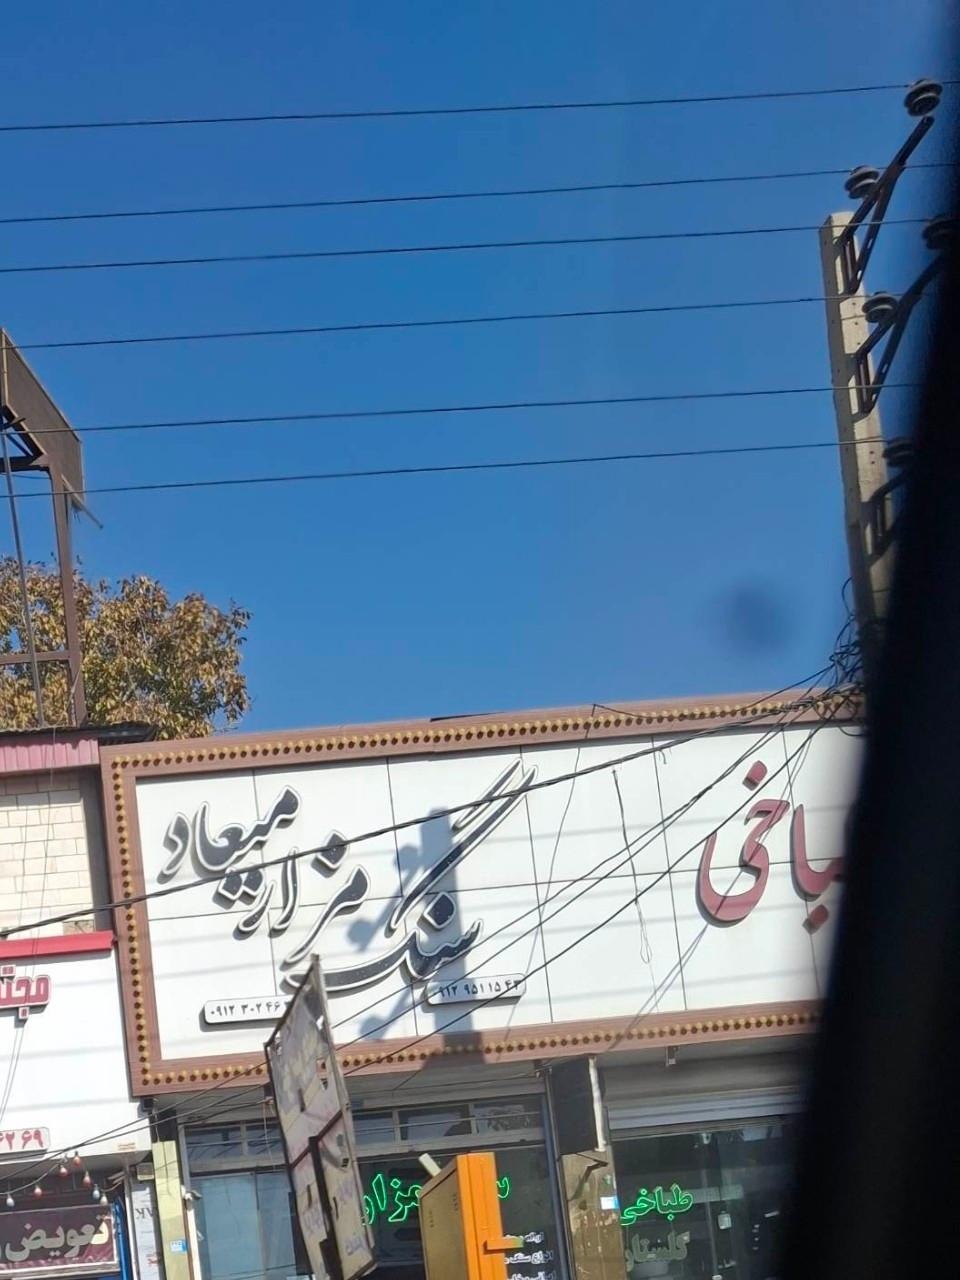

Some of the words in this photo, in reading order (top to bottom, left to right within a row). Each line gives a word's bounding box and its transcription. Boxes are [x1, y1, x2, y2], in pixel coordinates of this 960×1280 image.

[695, 760, 846, 934] باخی
[210, 1004, 235, 1017] ۰۹۱۲
[21, 1130, 44, 1150] ۶۹
[620, 1183, 693, 1226] طباخی
[4, 1214, 110, 1262] تعویض
